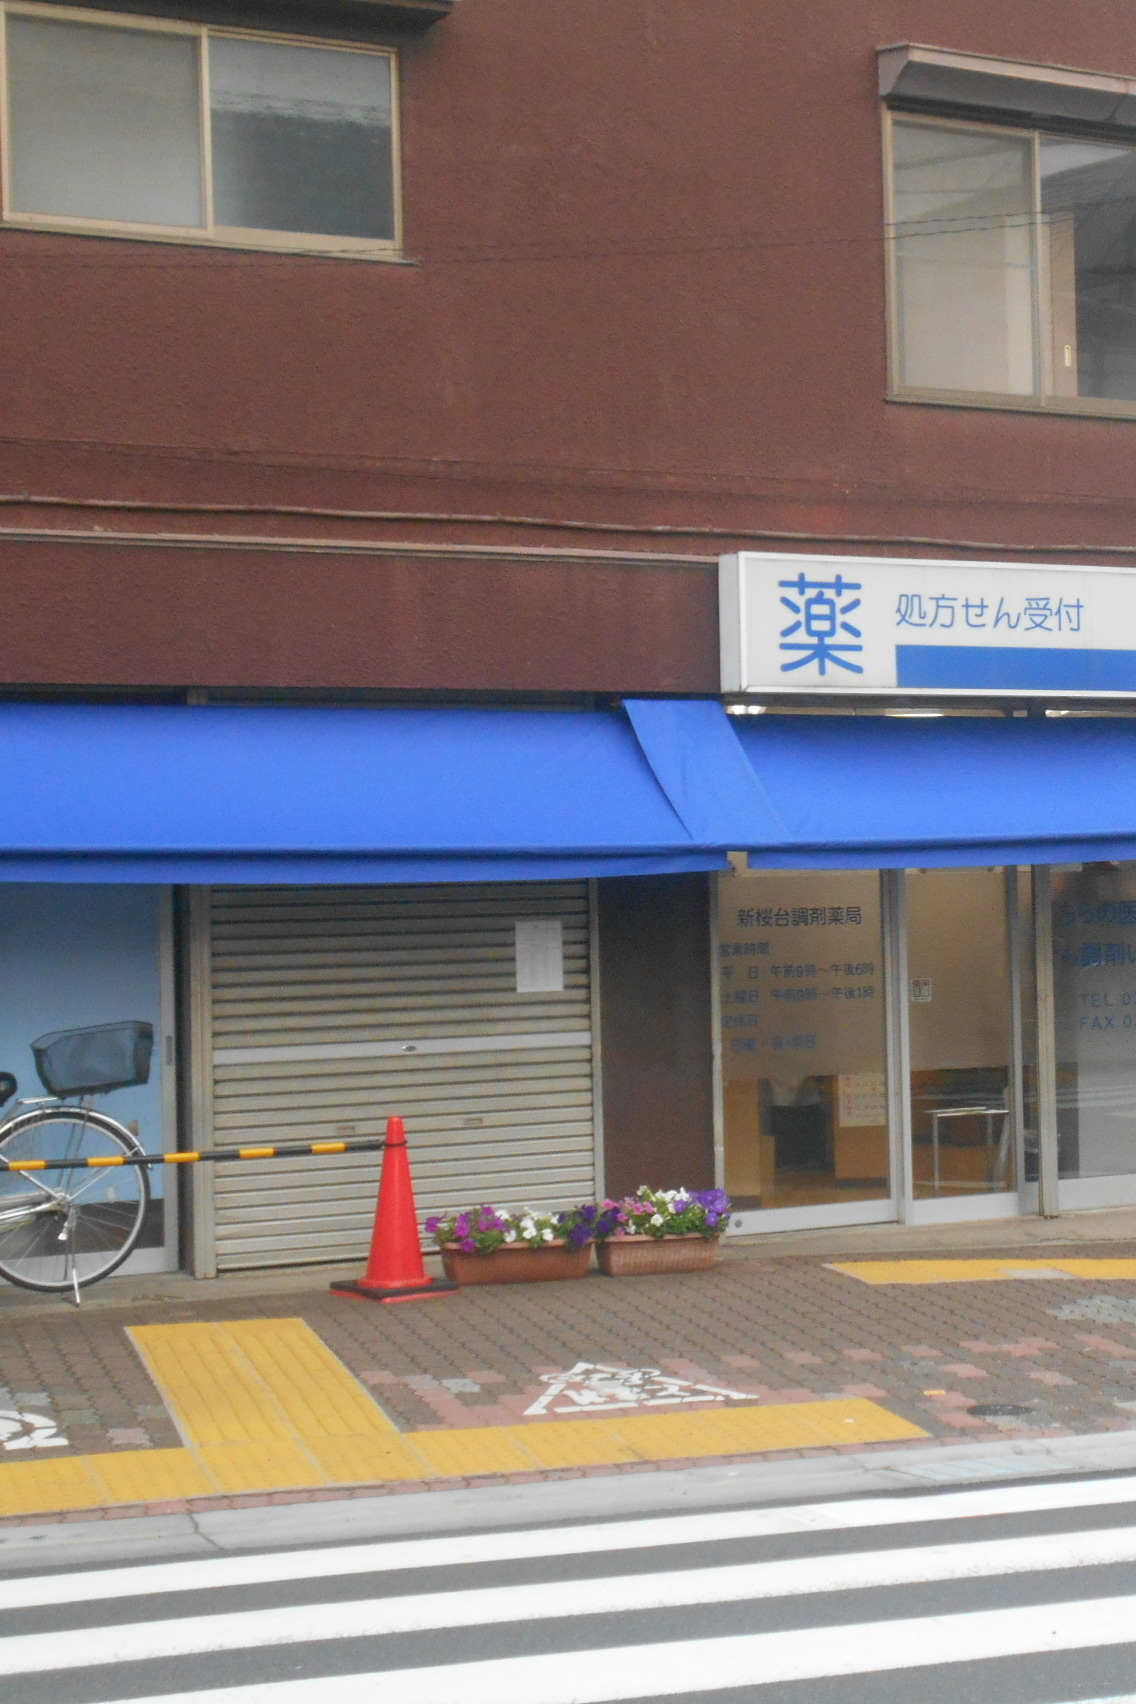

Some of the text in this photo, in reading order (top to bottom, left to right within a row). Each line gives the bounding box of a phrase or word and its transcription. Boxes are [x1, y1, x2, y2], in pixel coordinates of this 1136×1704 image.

[778, 572, 864, 676] 薬
[895, 594, 1084, 632] 処方せん受付
[736, 905, 862, 928] 新桜台調剤薬局
[1079, 992, 1114, 1008] TEL
[1078, 1015, 1116, 1031] FAX
